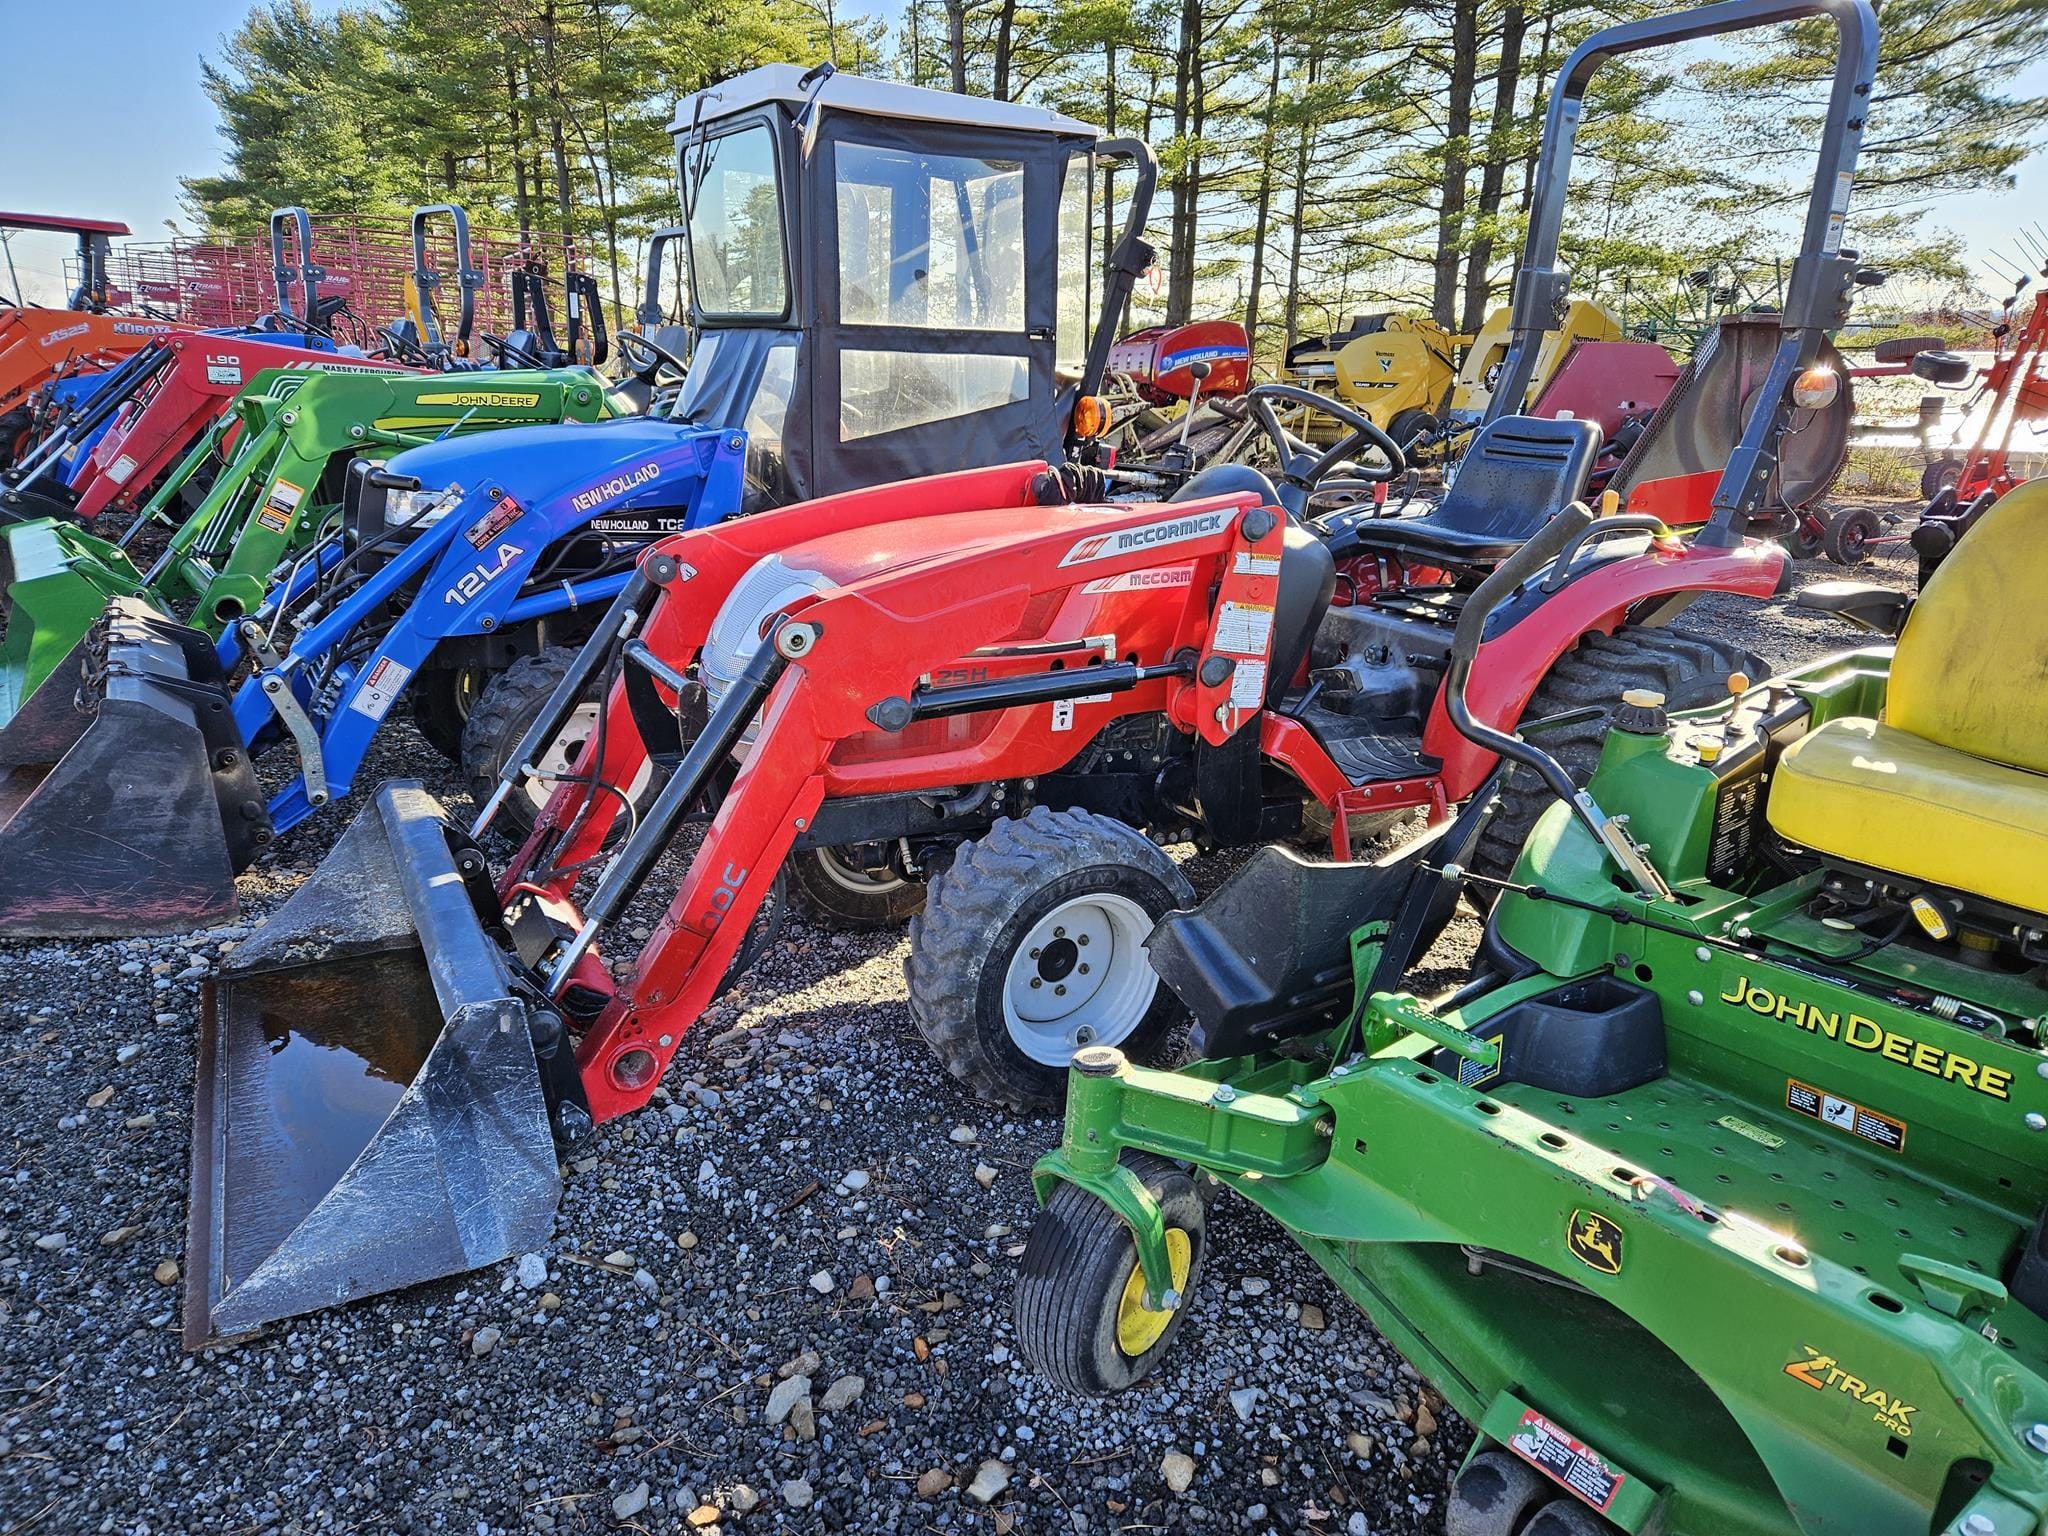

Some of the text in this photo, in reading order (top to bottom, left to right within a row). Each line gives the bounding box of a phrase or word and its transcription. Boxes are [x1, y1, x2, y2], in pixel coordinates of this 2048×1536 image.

[113, 322, 171, 335] KUBOTA
[206, 354, 240, 365] L90
[1174, 350, 1218, 366] NEW HOLLAND
[322, 364, 358, 374] MASSEY
[452, 394, 533, 406] JOHN DEERE
[571, 462, 661, 513] NEW HOLLAND
[590, 519, 610, 530] NEW
[610, 519, 649, 531] HOLLAND
[444, 542, 525, 607] 12LA
[1244, 604, 1270, 612] WARNING
[1721, 976, 2013, 1100] JOHN DEERE
[1873, 1412, 1912, 1437] PRO
[1543, 1423, 1572, 1446] DANGER
